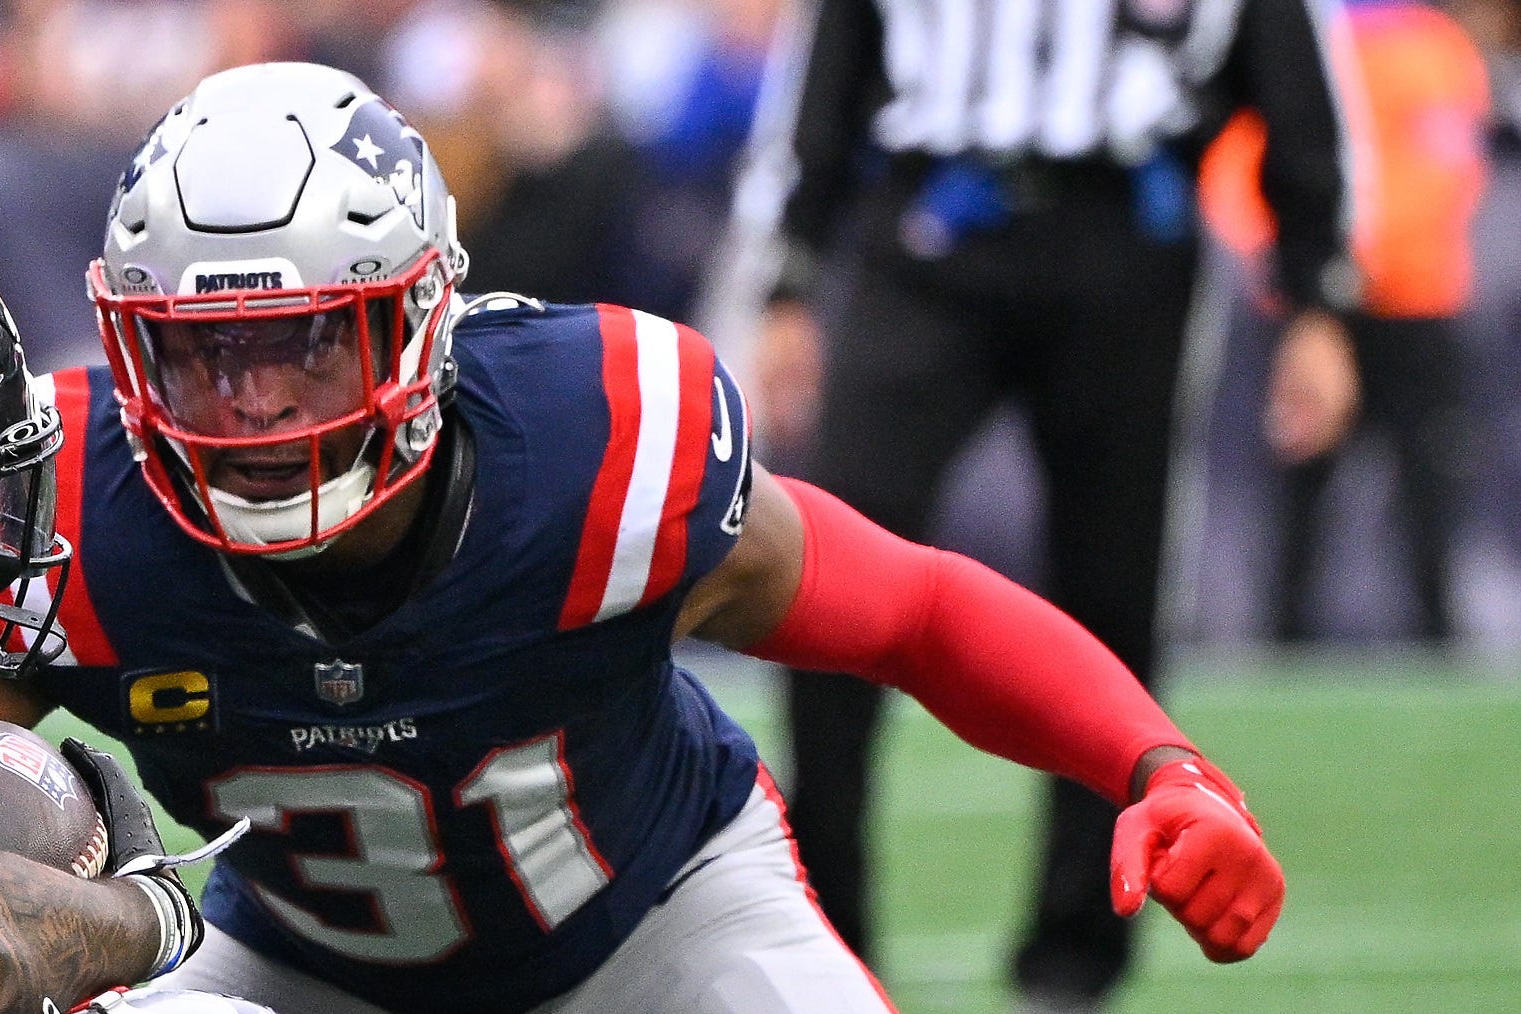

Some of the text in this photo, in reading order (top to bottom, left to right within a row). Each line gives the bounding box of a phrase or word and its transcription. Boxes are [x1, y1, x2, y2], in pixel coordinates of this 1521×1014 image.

[195, 271, 283, 295] PATRIOTS
[129, 671, 210, 723] C
[290, 718, 418, 752] PATRIOTS
[200, 728, 616, 965] 31
